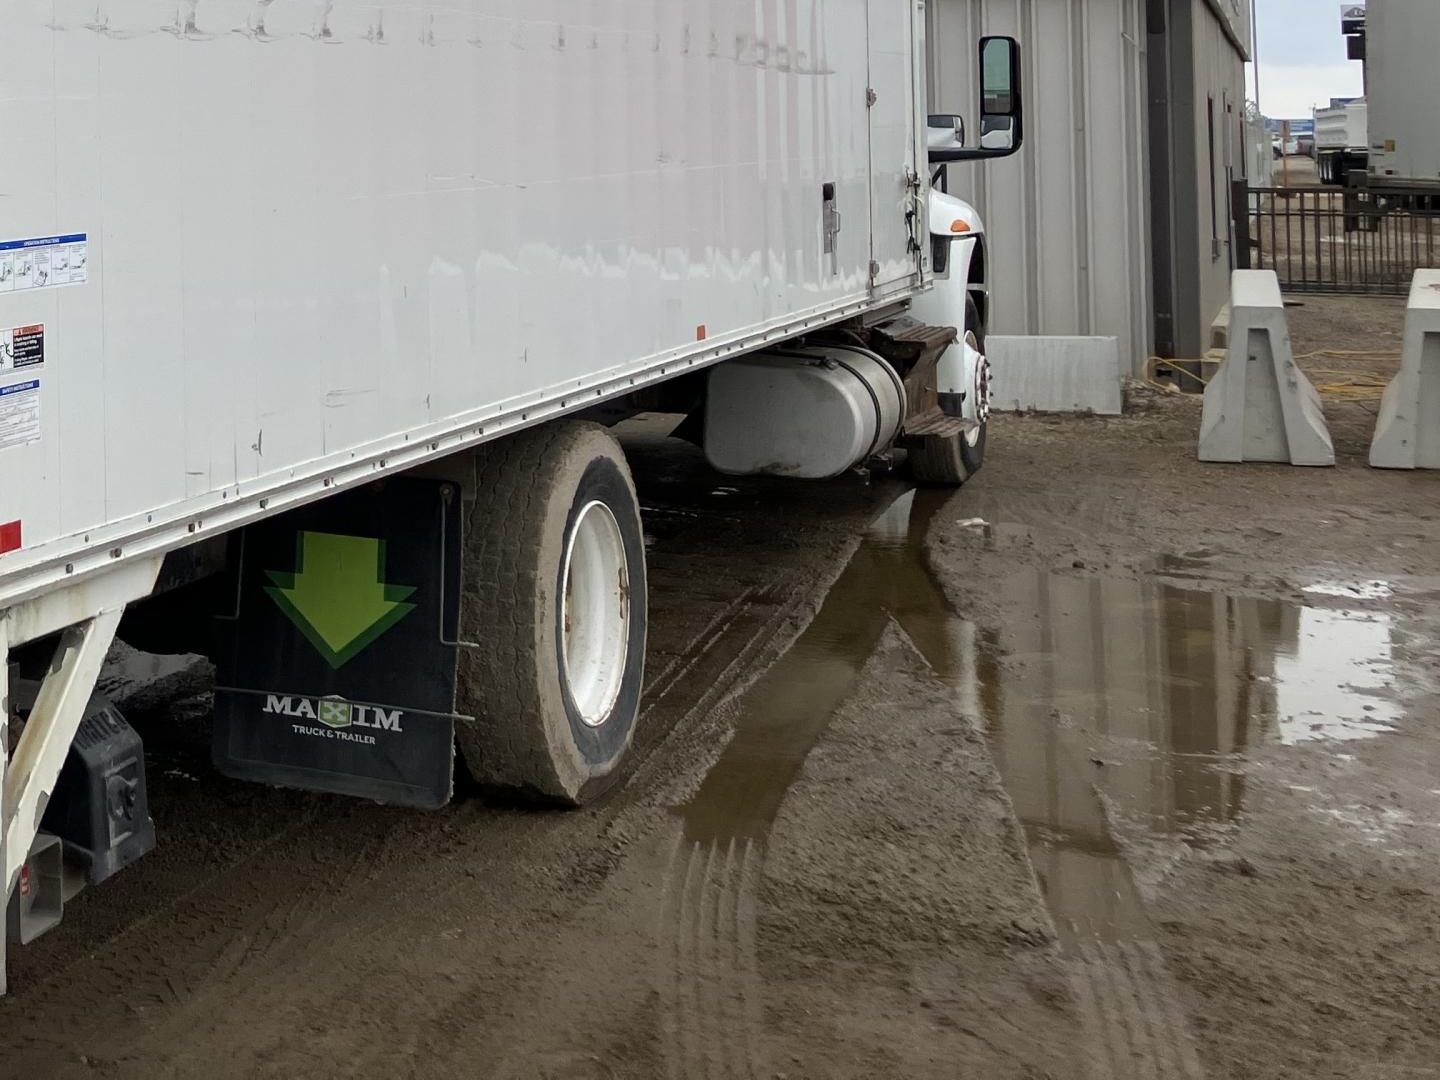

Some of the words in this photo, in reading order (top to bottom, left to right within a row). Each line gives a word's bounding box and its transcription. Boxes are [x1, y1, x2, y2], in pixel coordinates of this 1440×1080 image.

[262, 694, 403, 732] MAXIM
[292, 724, 325, 738] TRUCK
[335, 730, 376, 746] TRAILER
